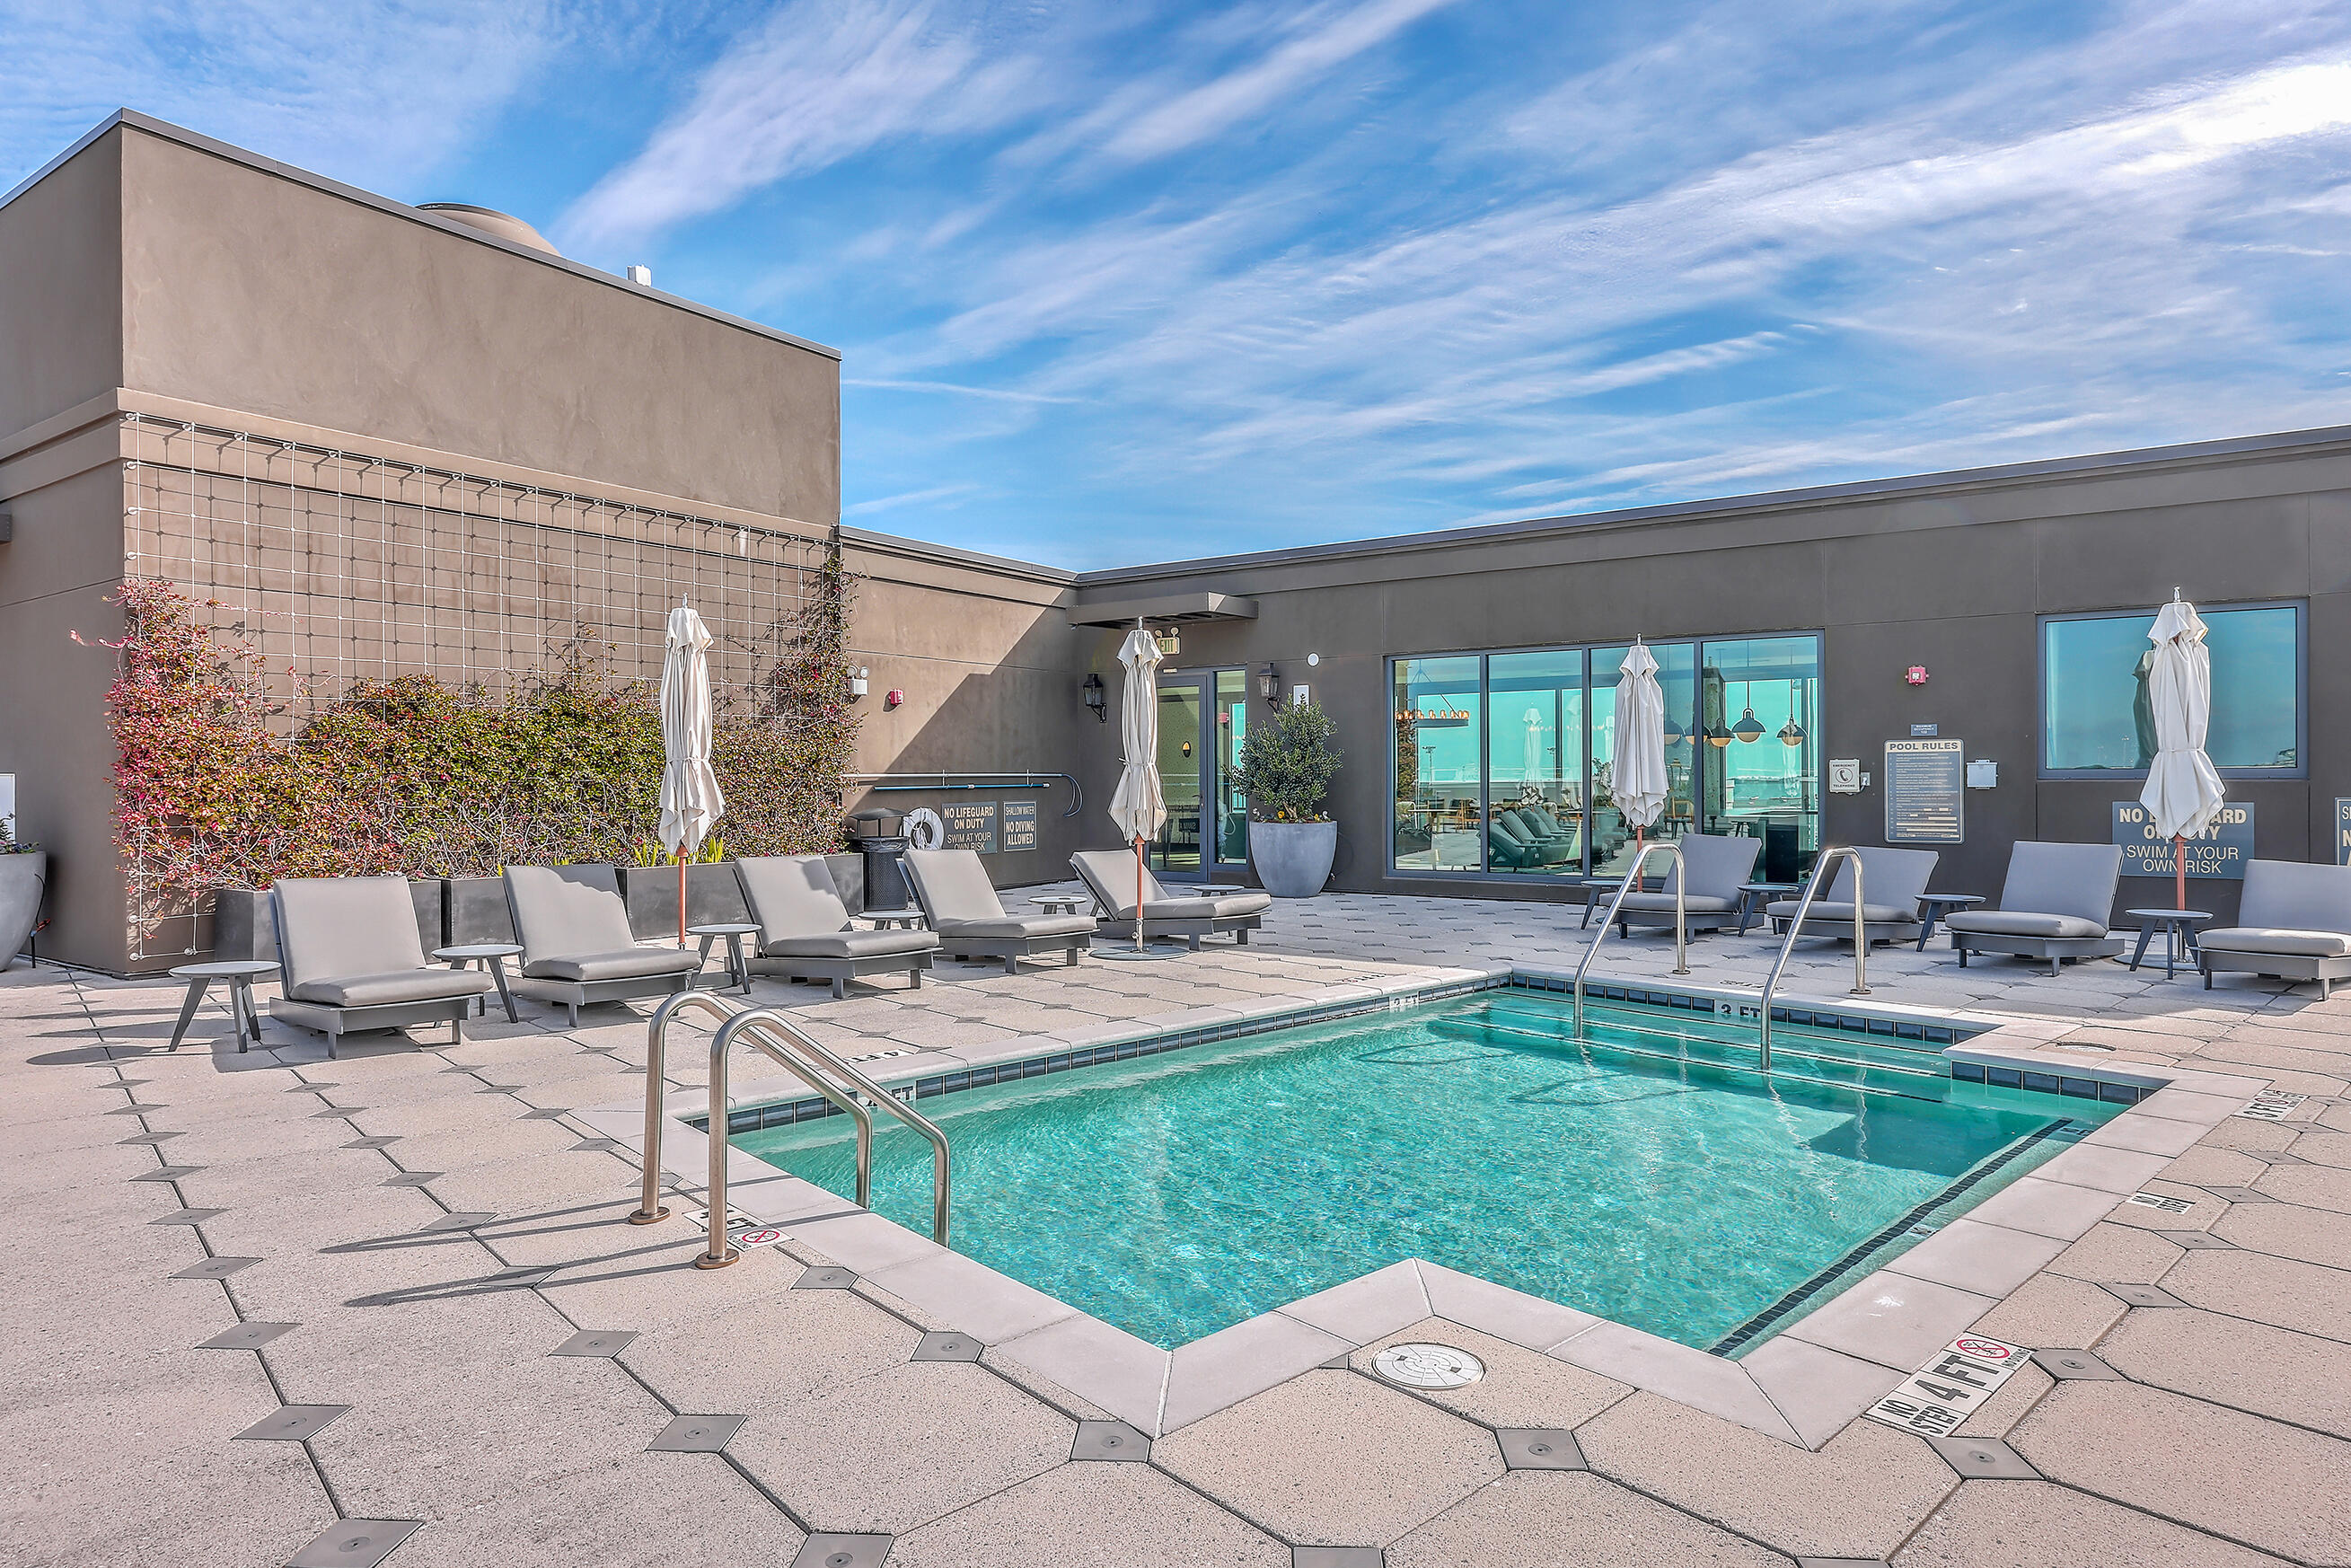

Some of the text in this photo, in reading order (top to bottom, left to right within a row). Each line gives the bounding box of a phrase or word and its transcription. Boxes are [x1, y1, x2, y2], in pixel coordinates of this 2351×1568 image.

[1159, 639, 1174, 652] EXIT
[944, 806, 994, 819] NO LIFEGUARD
[1005, 806, 1035, 816] SHALLOW WATER
[2119, 808, 2144, 823] NO
[954, 818, 984, 830] ON DUTY
[1006, 821, 1035, 833] NO DIVING
[947, 832, 991, 844] SWIM AT YOUR
[1007, 833, 1034, 846] ALLOWED
[971, 842, 985, 850] RISK
[2126, 845, 2168, 859] SWIM
[2194, 847, 2239, 859] YOUR
[2143, 859, 2222, 874] OWN RISK
[1914, 1354, 2000, 1402] 4 FT
[1877, 1399, 1920, 1419] NO
[1908, 1405, 1959, 1435] STEP
